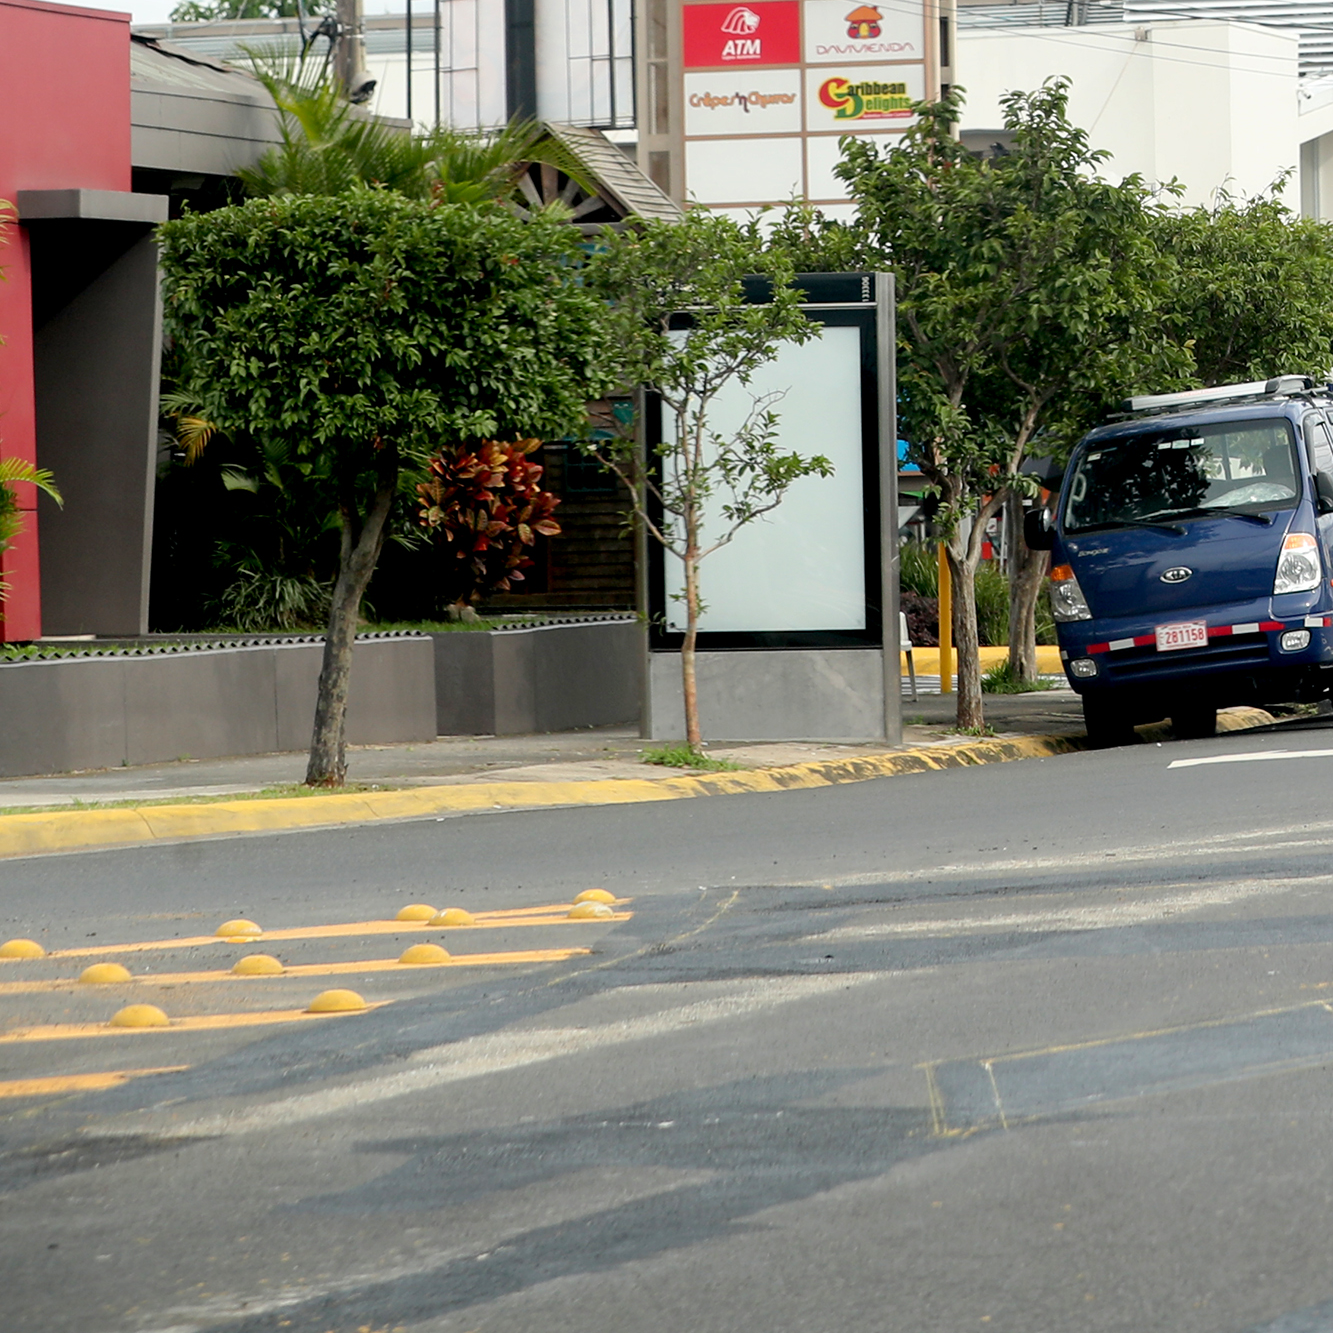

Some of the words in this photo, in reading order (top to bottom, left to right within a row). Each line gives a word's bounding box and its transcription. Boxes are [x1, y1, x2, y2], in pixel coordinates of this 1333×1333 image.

[721, 39, 761, 56] ATM
[815, 42, 915, 55] DAVIVIENDA
[1165, 570, 1187, 580] KIA
[1165, 628, 1205, 645] 281158
